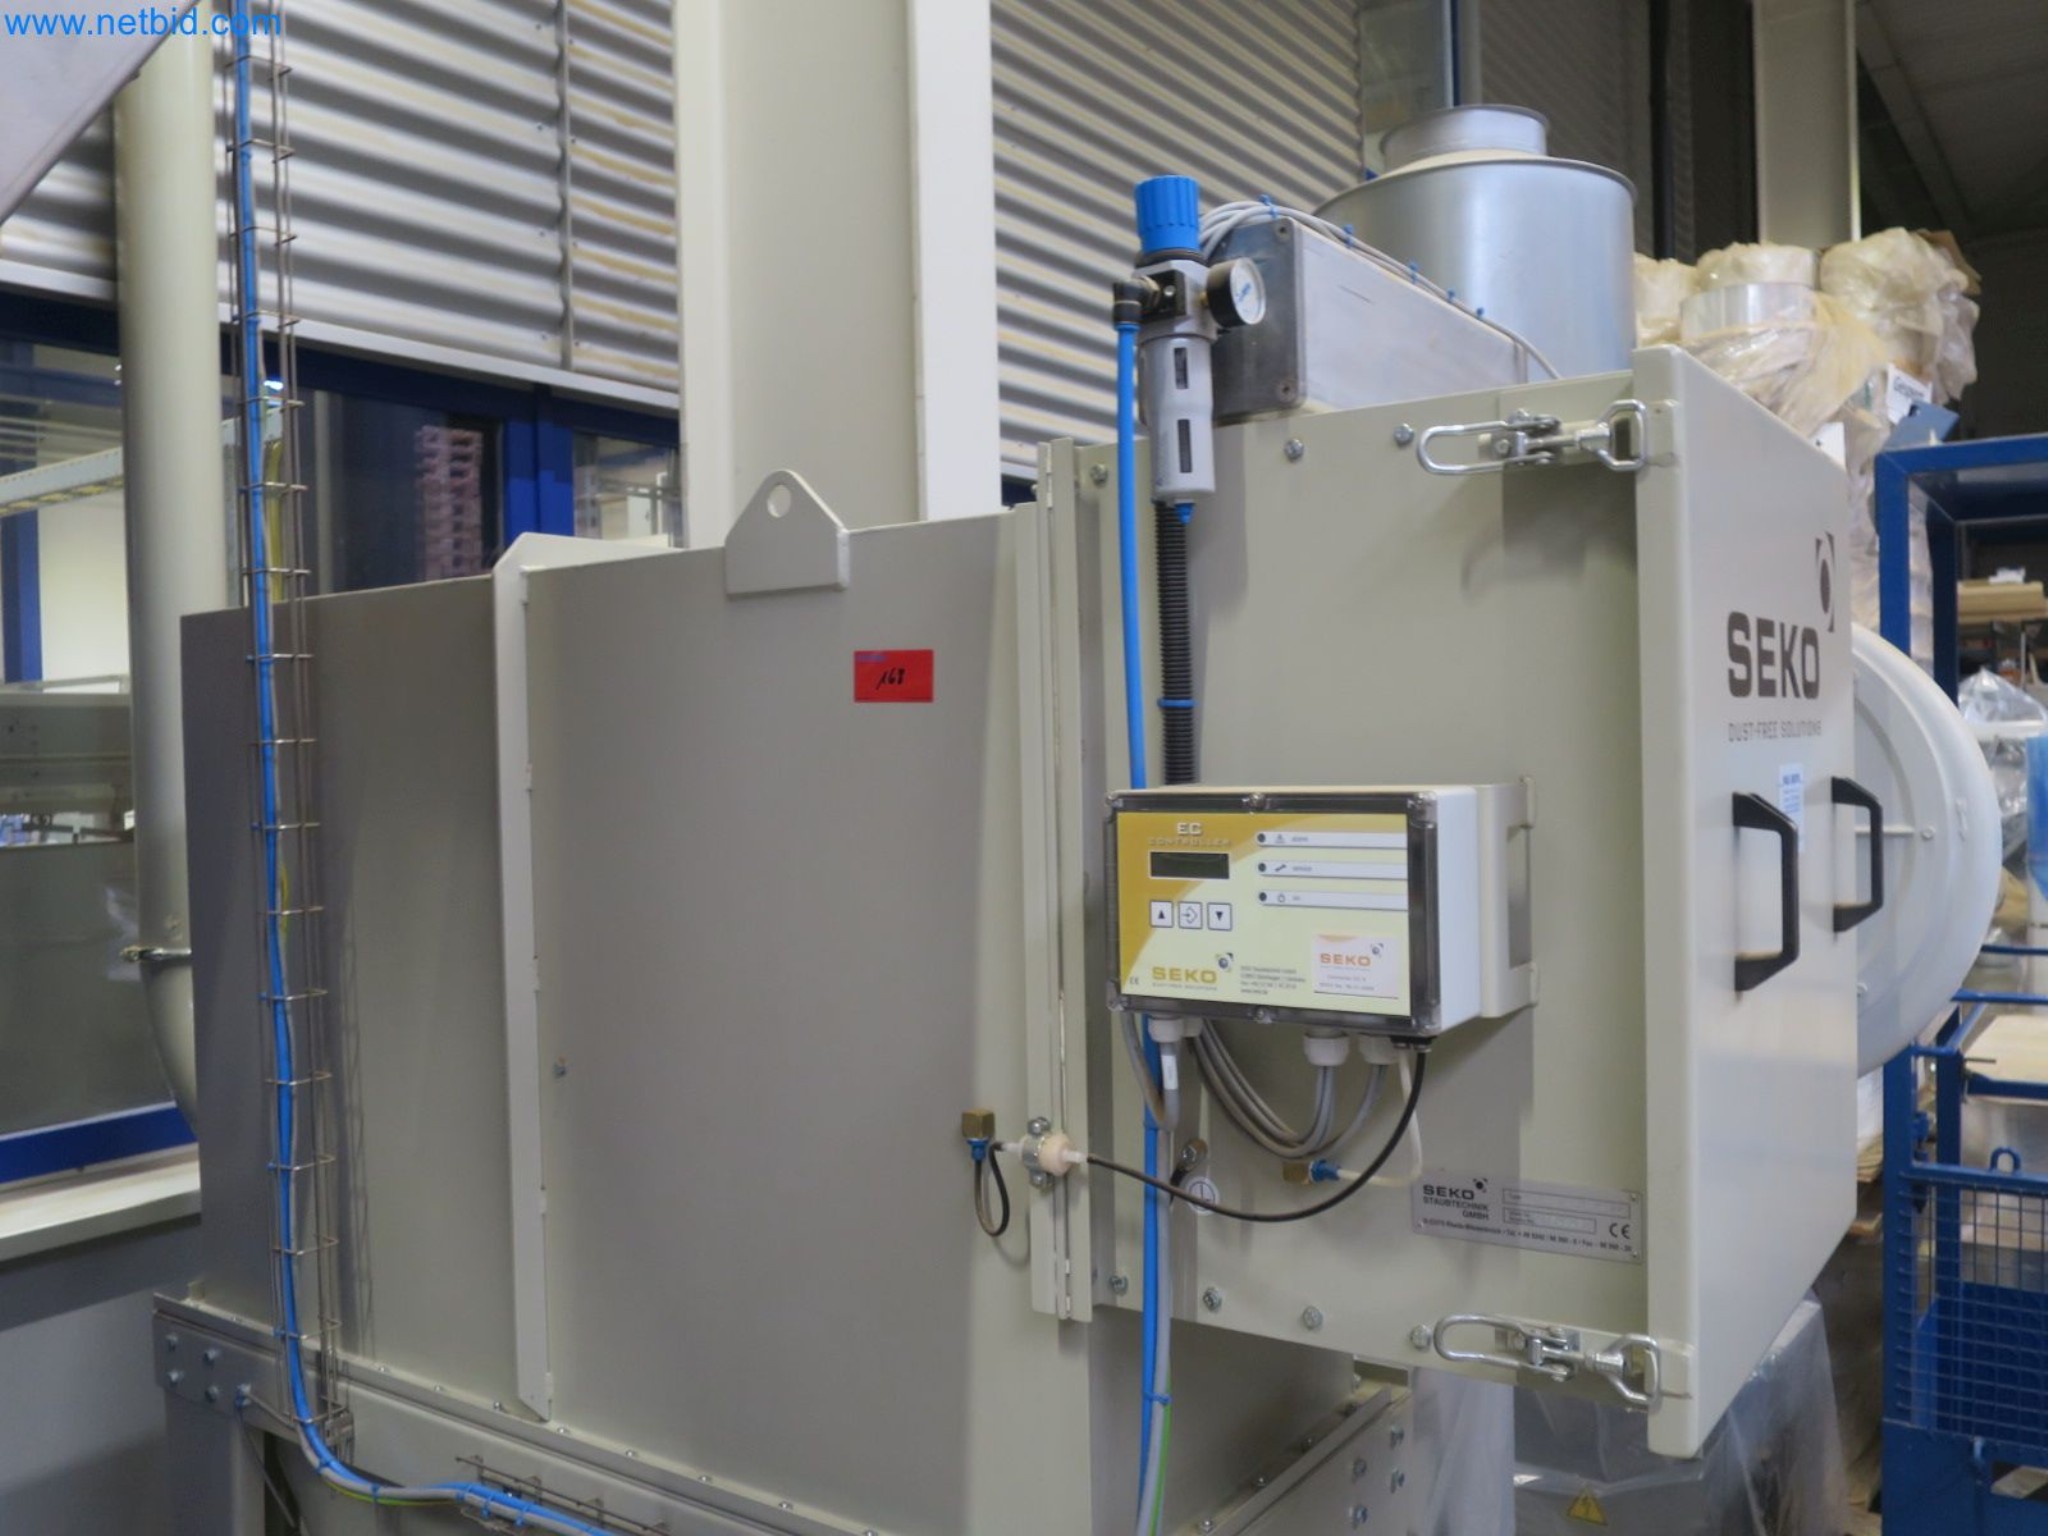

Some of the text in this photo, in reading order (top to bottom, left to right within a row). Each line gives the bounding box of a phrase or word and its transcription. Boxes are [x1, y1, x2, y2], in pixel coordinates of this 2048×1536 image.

[1727, 611, 1820, 700] SEKO
[1177, 822, 1202, 836] EC
[1319, 953, 1371, 967] SEKO
[1152, 966, 1218, 984] SEKO
[1423, 1184, 1475, 1200] SEKO
